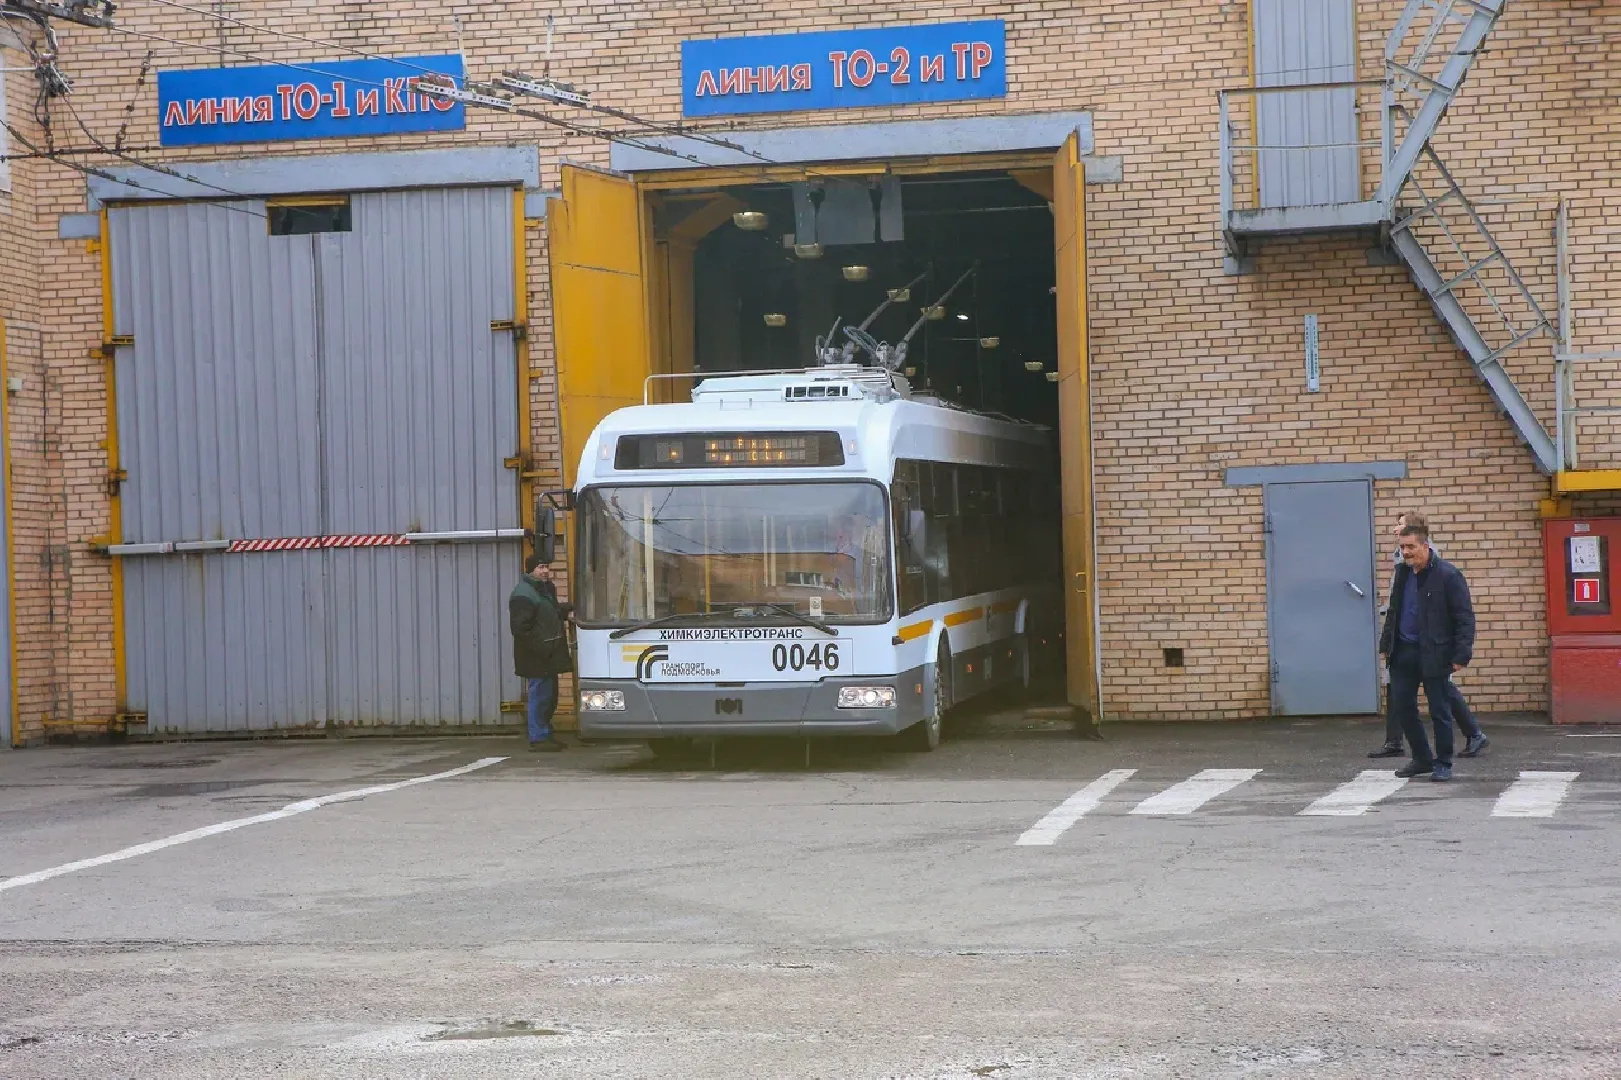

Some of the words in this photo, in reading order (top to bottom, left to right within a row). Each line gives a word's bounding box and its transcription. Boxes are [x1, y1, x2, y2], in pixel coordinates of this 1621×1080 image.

[829, 46, 910, 88] ТО-2
[921, 55, 944, 82] и
[952, 42, 992, 80] ТР
[277, 81, 350, 119] ТО-1
[357, 88, 379, 115] и
[659, 629, 803, 640] ХИМКИЭЛЕКТРОТРАНС
[772, 643, 839, 672] 0046
[661, 669, 720, 677] ПОДМОСКОВЬЯ
